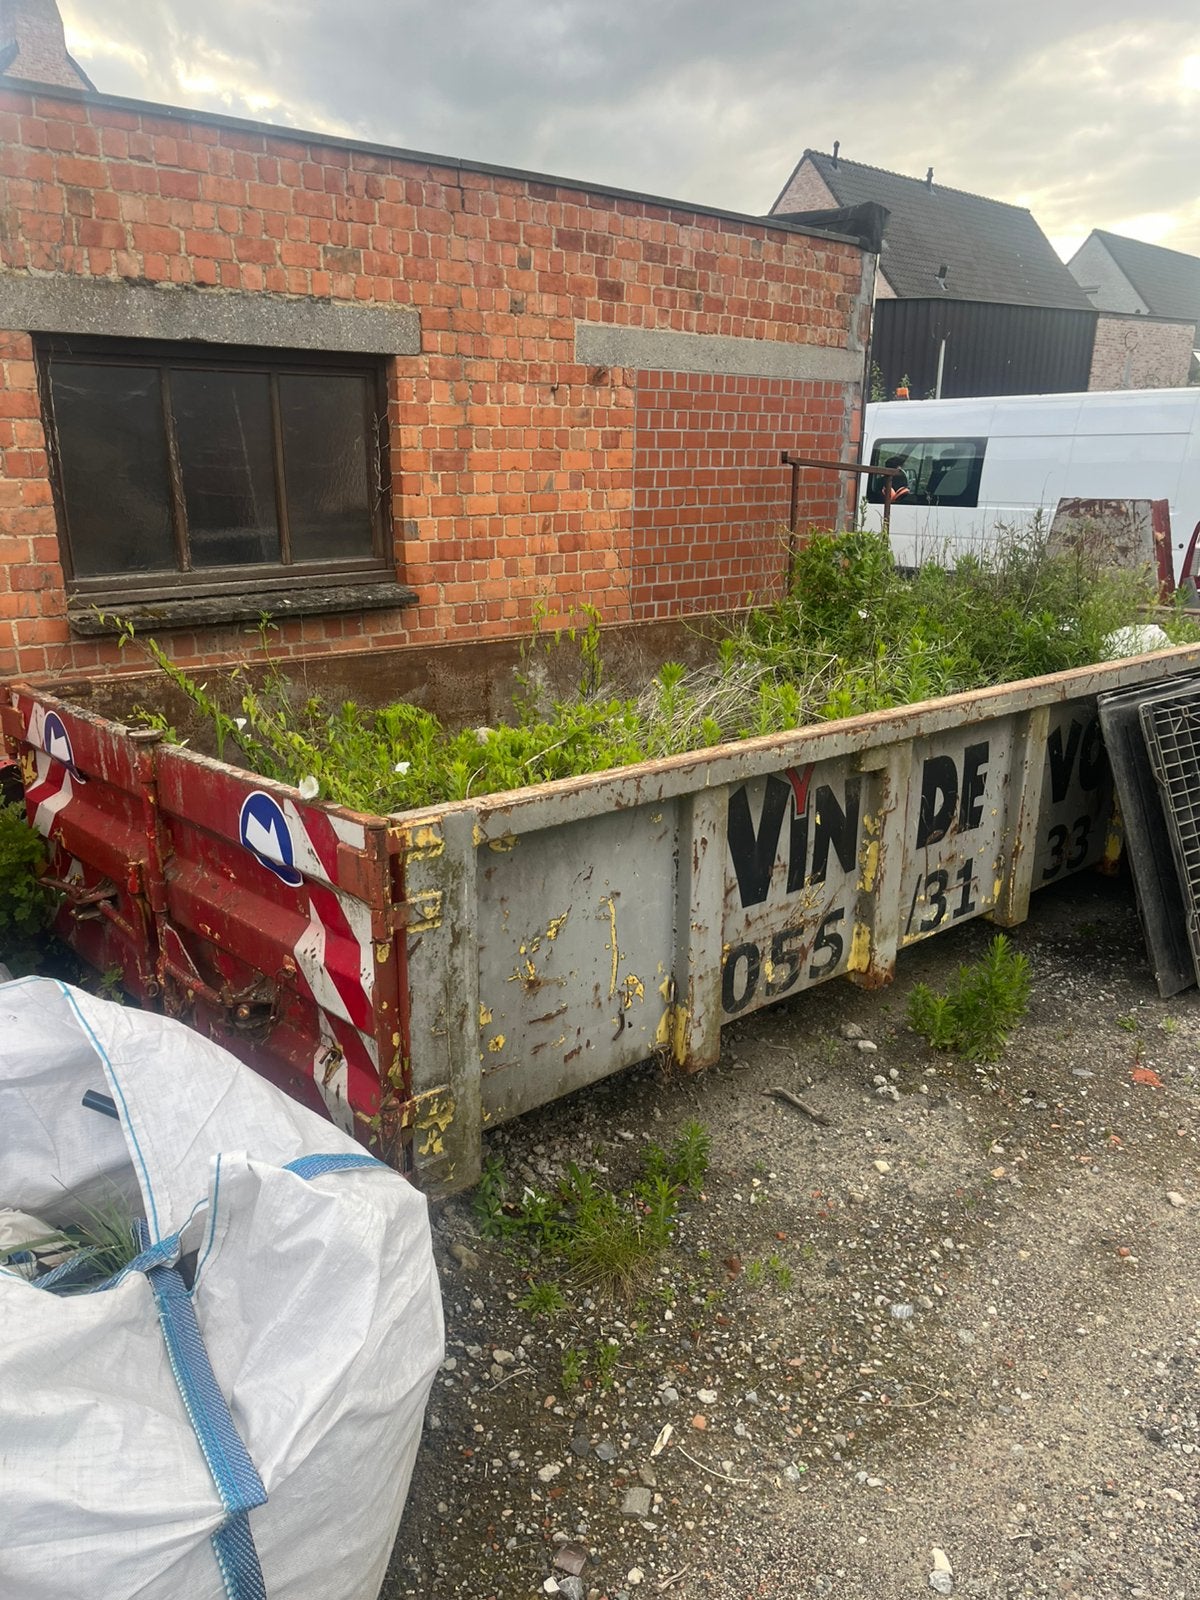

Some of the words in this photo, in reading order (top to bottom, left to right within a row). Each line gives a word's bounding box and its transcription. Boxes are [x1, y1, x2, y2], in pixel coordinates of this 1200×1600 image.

[916, 741, 989, 850] DE
[722, 907, 845, 1014] 055
[1043, 815, 1091, 880] 33
